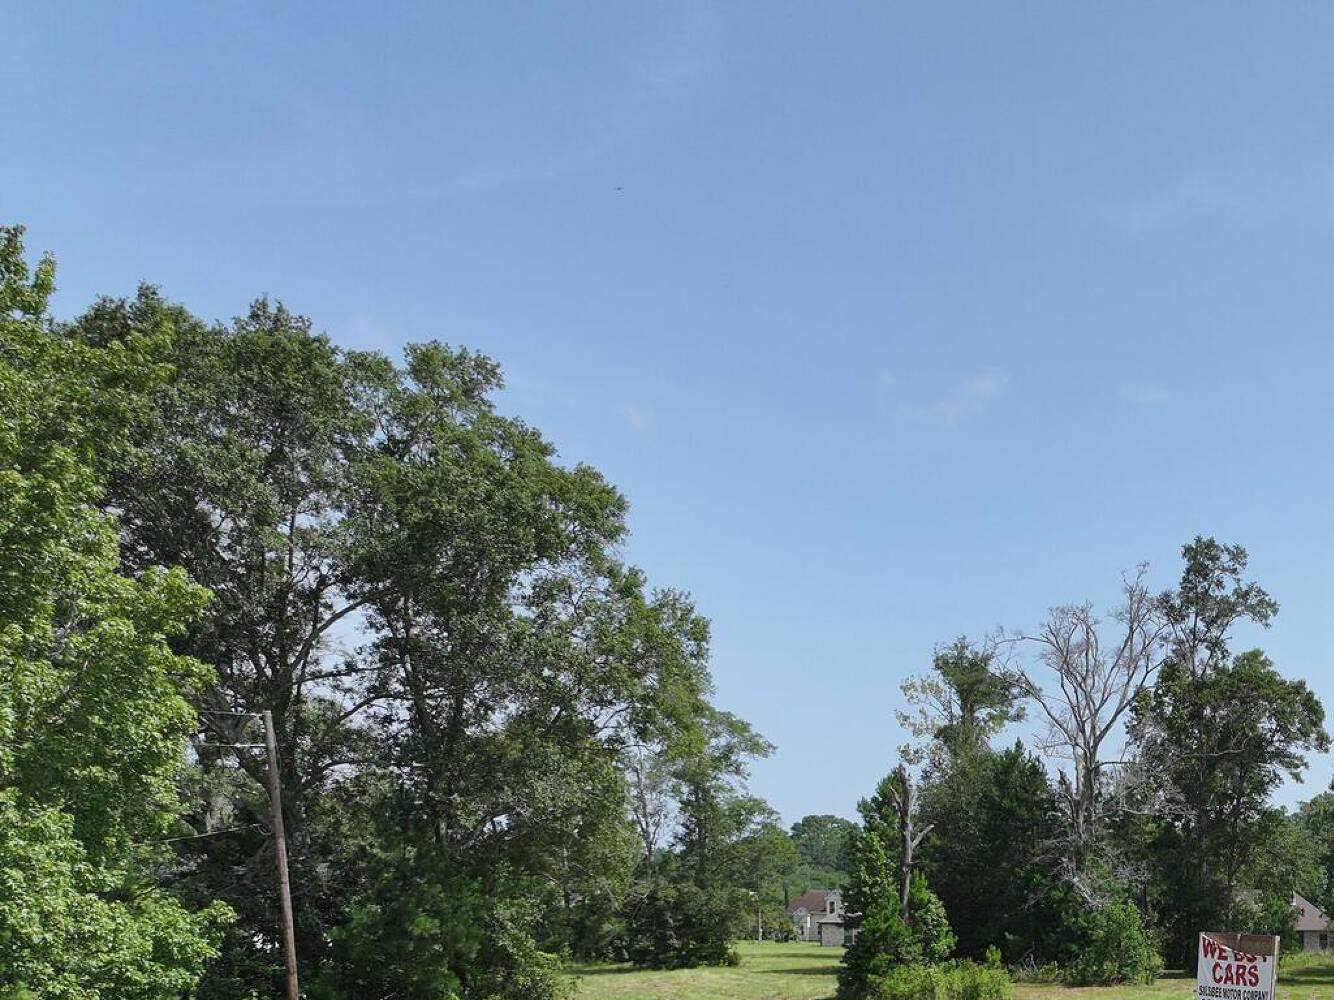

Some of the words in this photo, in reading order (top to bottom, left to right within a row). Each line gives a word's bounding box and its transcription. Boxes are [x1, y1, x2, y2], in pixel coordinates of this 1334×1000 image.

[1202, 938, 1229, 961] WE
[1212, 962, 1259, 987] CARS
[1222, 988, 1241, 1000] MOTOR
